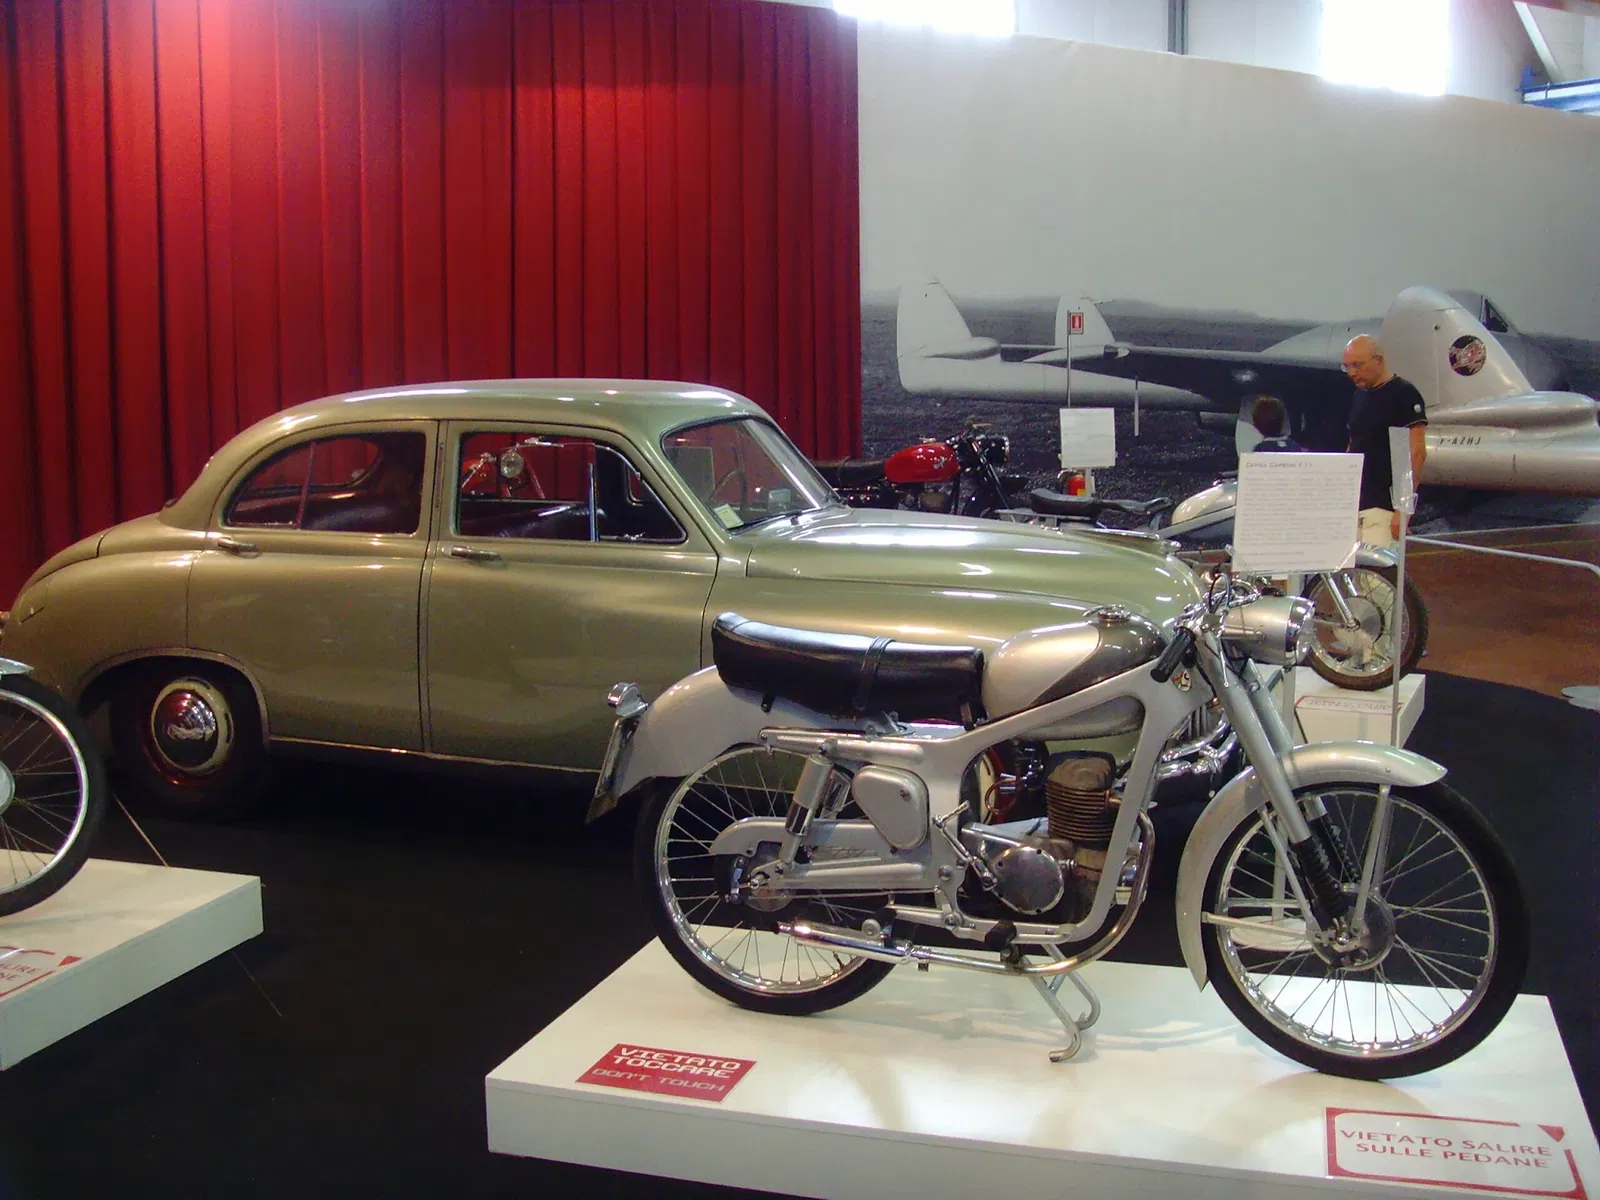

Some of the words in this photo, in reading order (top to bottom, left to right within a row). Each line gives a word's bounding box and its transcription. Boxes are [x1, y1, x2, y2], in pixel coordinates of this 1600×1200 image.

[614, 1055, 735, 1079] TOCCARE
[620, 1047, 741, 1070] VIETATO
[658, 1076, 726, 1092] TOUCH
[1340, 1129, 1453, 1148] VIETATO
[1462, 1140, 1553, 1157] SALIRE
[1356, 1143, 1434, 1158] SULLE
[1443, 1151, 1550, 1169] PEDANE
